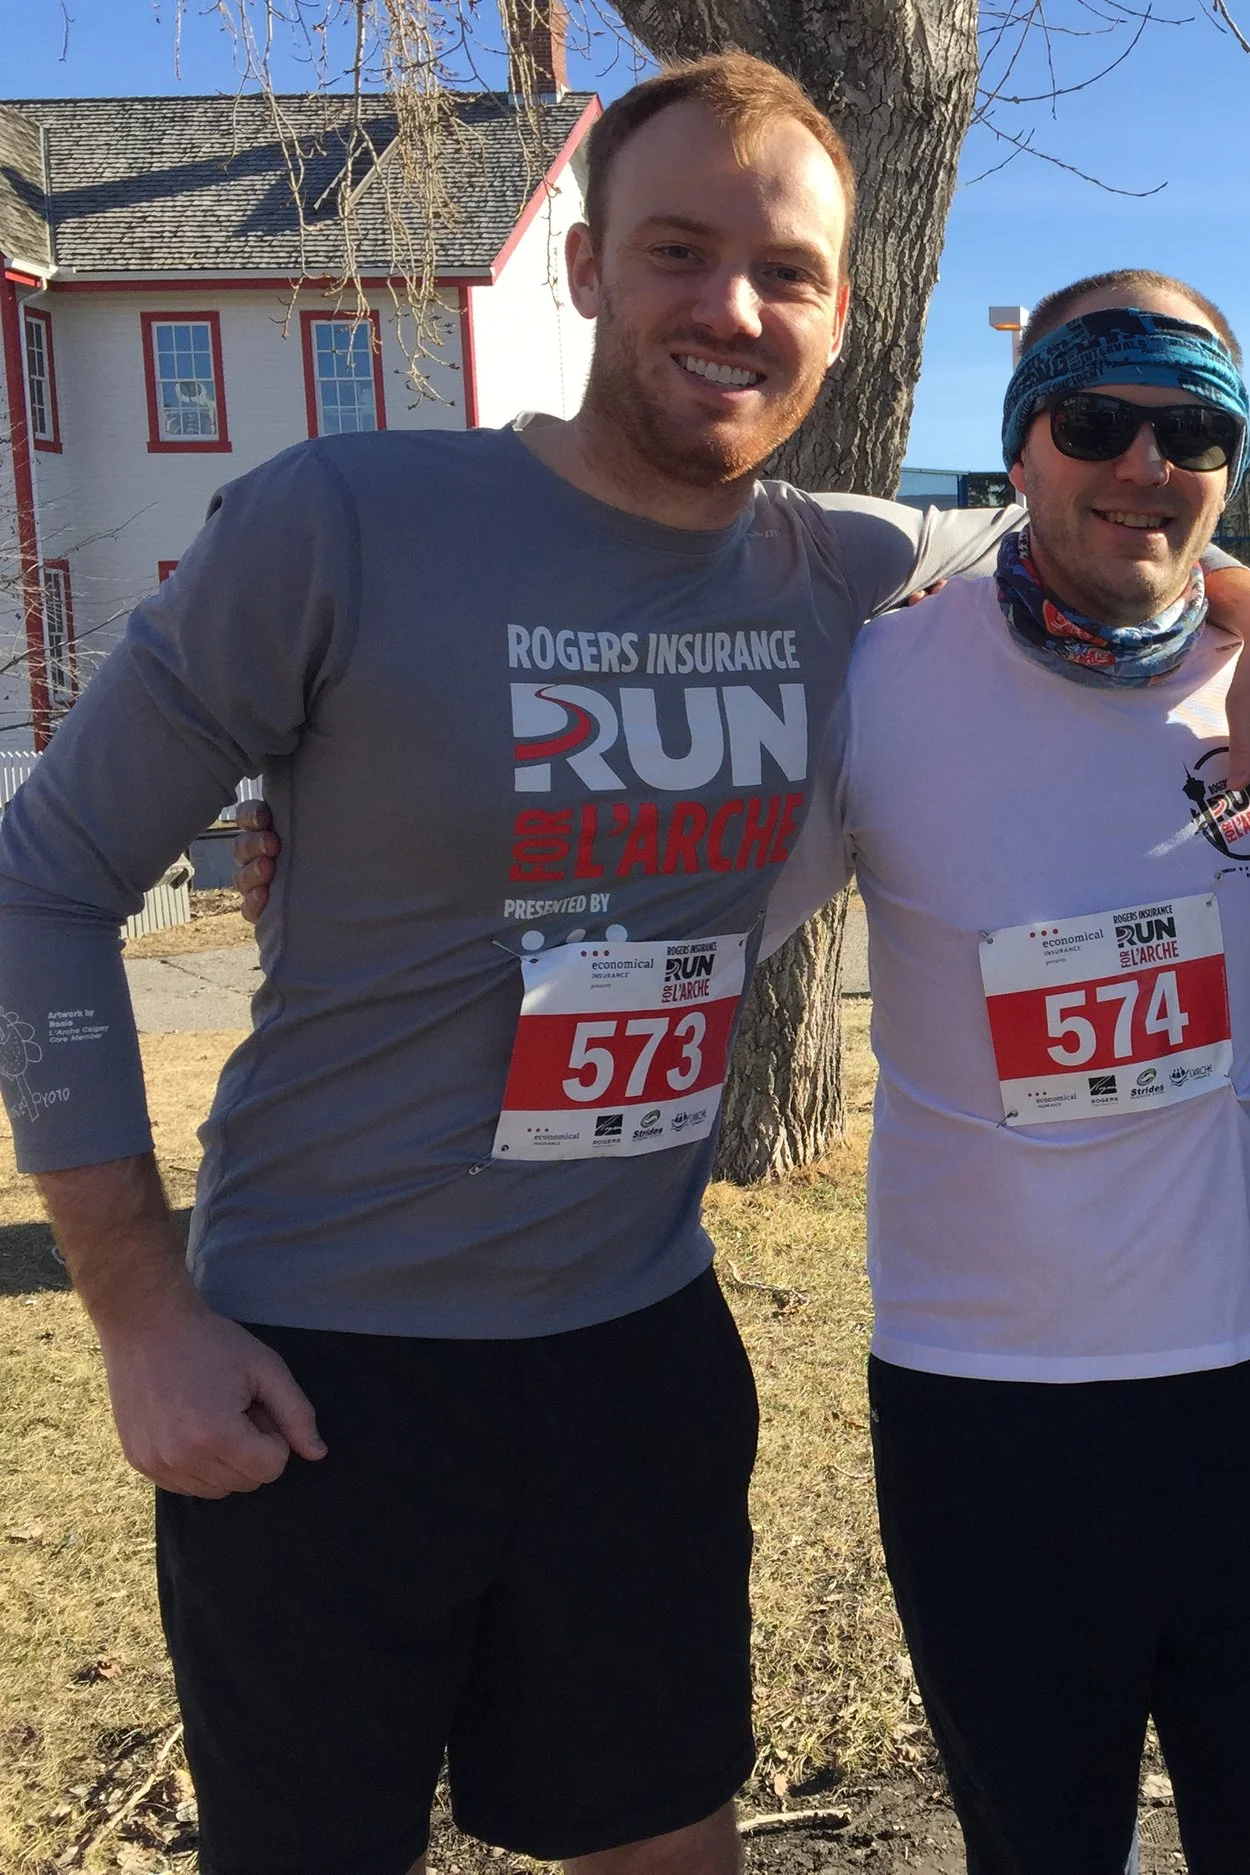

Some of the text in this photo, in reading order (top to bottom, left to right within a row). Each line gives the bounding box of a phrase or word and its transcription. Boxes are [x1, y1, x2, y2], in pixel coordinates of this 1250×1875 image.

[507, 624, 800, 674] ROGERS INSURANCE
[510, 683, 808, 792] RUN
[509, 792, 804, 882] FOR L'ARCHE
[1221, 822, 1238, 844] FOR
[504, 893, 610, 919] PRESENTED BY
[1113, 905, 1173, 924] ROGERS INSURANCE
[1042, 928, 1104, 948] economical
[1115, 917, 1177, 948] RUN
[667, 945, 690, 956] ROGERS
[1120, 941, 1179, 968] FOR L'ARCHE
[592, 958, 654, 970] economical
[664, 954, 715, 982] RUN
[661, 979, 710, 1003] FOR L'ARCHE
[48, 1010, 83, 1020] Artwork
[1045, 970, 1189, 1067] 574
[562, 1012, 706, 1102] 573
[1130, 1084, 1165, 1096] Strides
[632, 1127, 664, 1139] Strides
